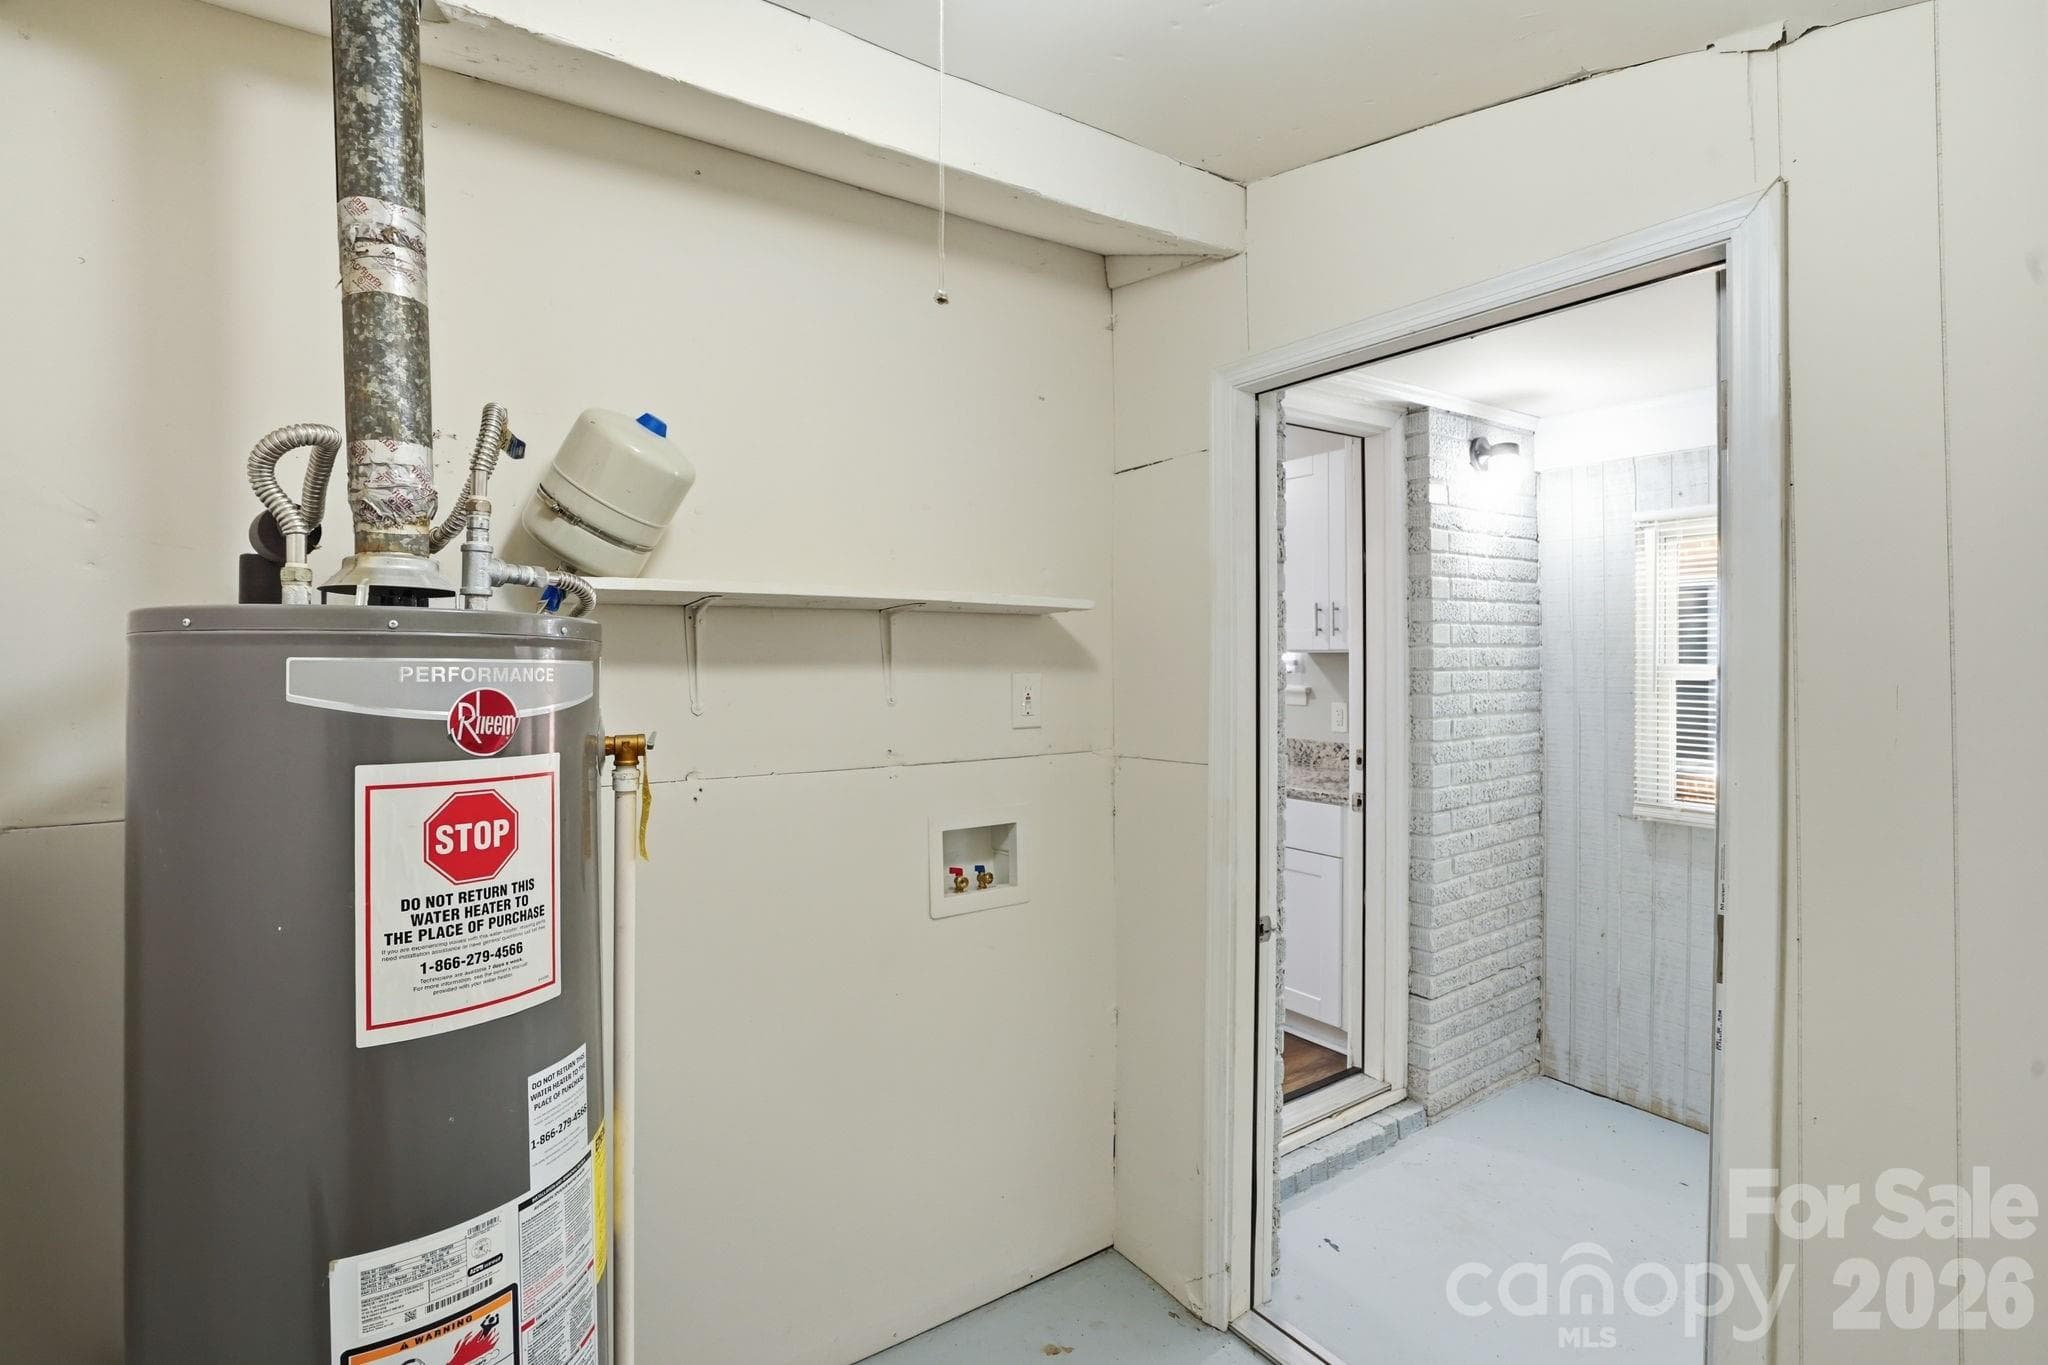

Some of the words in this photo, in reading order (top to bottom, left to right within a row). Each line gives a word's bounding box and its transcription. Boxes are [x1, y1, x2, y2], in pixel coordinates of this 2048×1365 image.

[400, 666, 554, 682] PERFORMANCE
[458, 691, 516, 744] Rheem
[435, 818, 510, 855] STOP
[400, 898, 420, 912] DO
[426, 893, 453, 908] NOT
[458, 884, 508, 904] RETURN
[511, 878, 534, 894] THIS
[411, 908, 460, 927] WATER
[465, 898, 511, 918] HEATER
[515, 894, 528, 908] TO
[384, 931, 412, 946] THE
[418, 923, 463, 942] PLACE
[468, 919, 484, 933] OF
[489, 905, 545, 929] PURCHASE
[420, 942, 523, 974] 1-866-279-4566
[530, 1085, 552, 1101] WATER
[552, 1073, 572, 1089] HEATER
[572, 1068, 578, 1077] TO
[532, 1081, 542, 1090] DO
[543, 1072, 557, 1084] NOT
[556, 1060, 576, 1077] RETURN
[534, 1096, 552, 1111] PLACE
[553, 1091, 561, 1099] OF
[561, 1074, 584, 1095] PURCHASE
[415, 1315, 472, 1345] WARNING
